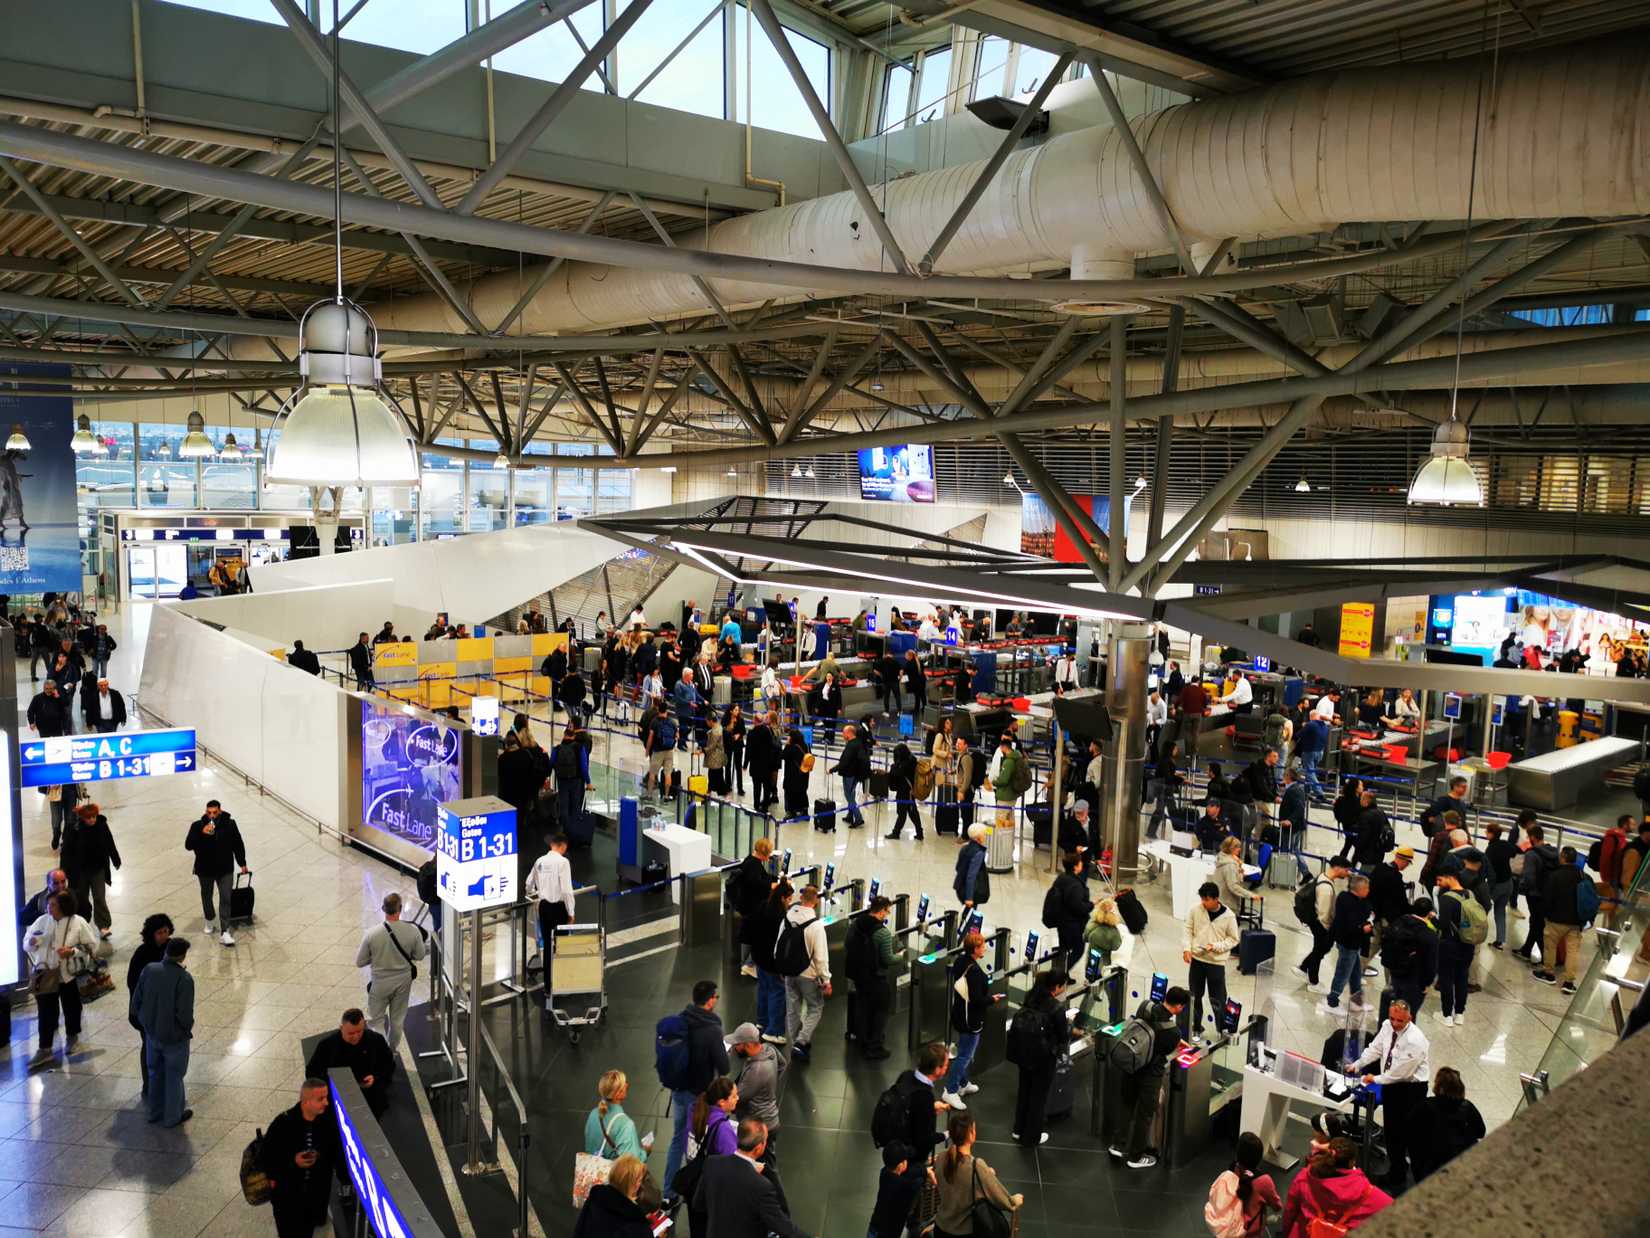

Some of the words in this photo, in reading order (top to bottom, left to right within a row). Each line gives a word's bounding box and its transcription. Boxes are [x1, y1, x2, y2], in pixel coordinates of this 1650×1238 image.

[947, 631, 956, 641] 14
[1256, 656, 1267, 667] 12
[119, 737, 132, 755] C
[415, 734, 431, 752] Fast
[431, 739, 448, 757] Lane
[99, 760, 112, 778] B
[117, 757, 150, 777] 1-31
[381, 802, 405, 829] Fast
[406, 812, 432, 839] Lane
[461, 838, 474, 861] B
[479, 832, 513, 858] 1-31
